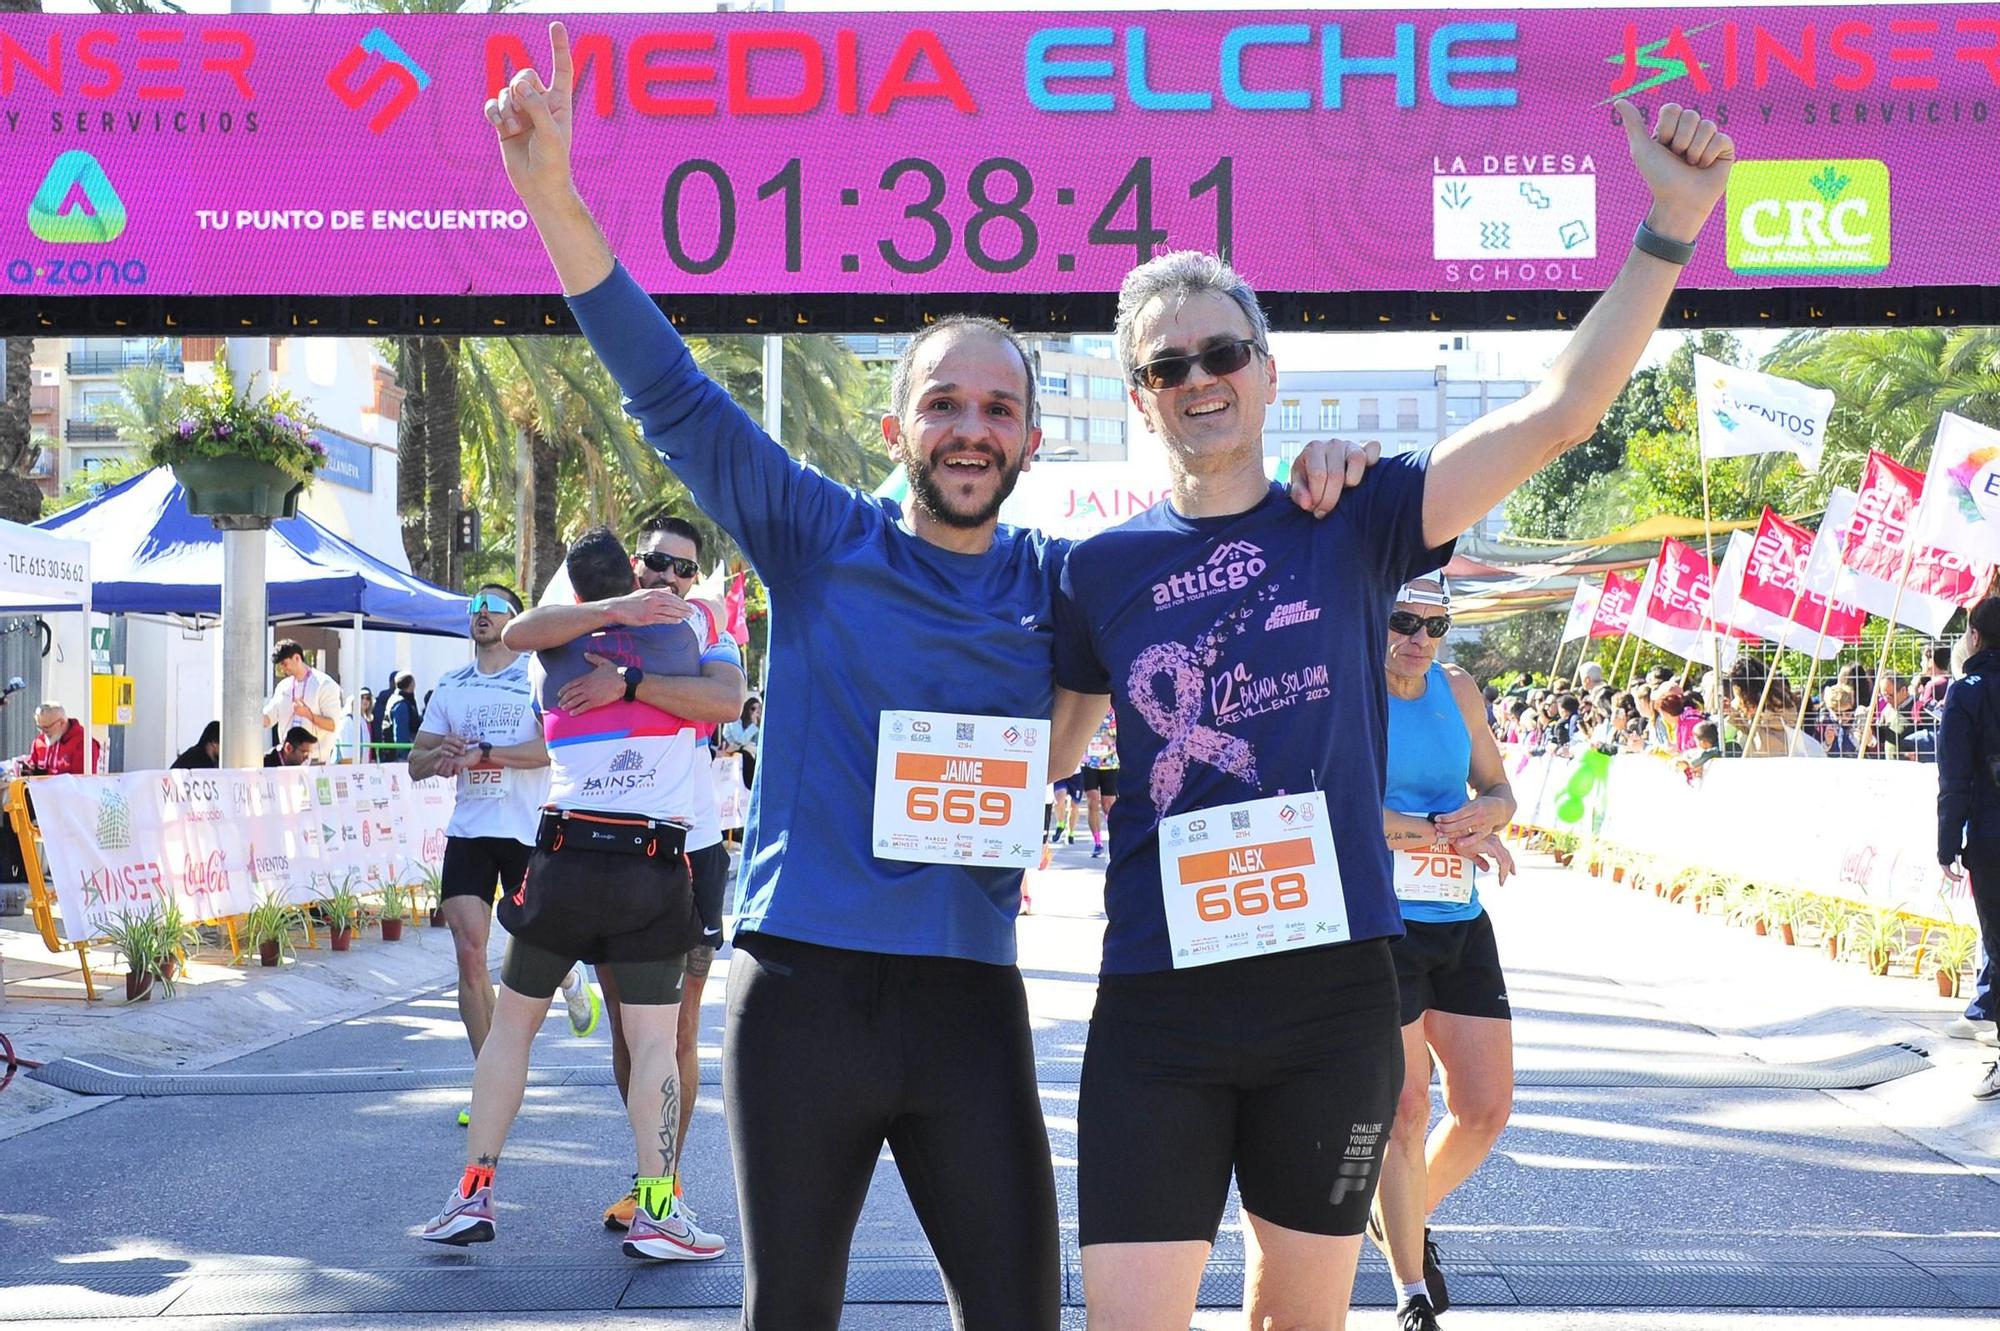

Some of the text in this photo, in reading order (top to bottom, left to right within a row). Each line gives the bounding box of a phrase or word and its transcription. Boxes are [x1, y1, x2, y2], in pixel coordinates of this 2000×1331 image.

[484, 22, 1519, 118] MEDIA ELCHE
[51, 110, 259, 133] SERVICIOS
[1433, 153, 1596, 174] LA DEVESA
[196, 208, 528, 231] TU PUNTO DE ENCUENTRO
[661, 156, 1234, 274] 01:38:41
[1740, 197, 1872, 248] CRC
[1446, 263, 1584, 282] SCHOOL
[9, 553, 84, 583] TLF. 615 30 56 62
[1152, 558, 1266, 605] atticgo
[1172, 598, 1185, 607] FOR
[1187, 592, 1205, 602] YOUR
[1206, 586, 1228, 597] HOME
[1264, 607, 1321, 632] CREVILLENT
[1273, 600, 1308, 618] CORRE
[1240, 676, 1279, 708] BAJADA
[1305, 687, 1330, 701] 2023
[469, 771, 502, 785] 1272
[940, 759, 983, 784] JAIME
[906, 786, 1012, 827] 669
[256, 856, 289, 873] EVENTOS
[1228, 848, 1266, 876] ALEX
[1411, 855, 1462, 879] 702
[1196, 872, 1309, 922] 668
[1344, 1146, 1373, 1156] AND RUN
